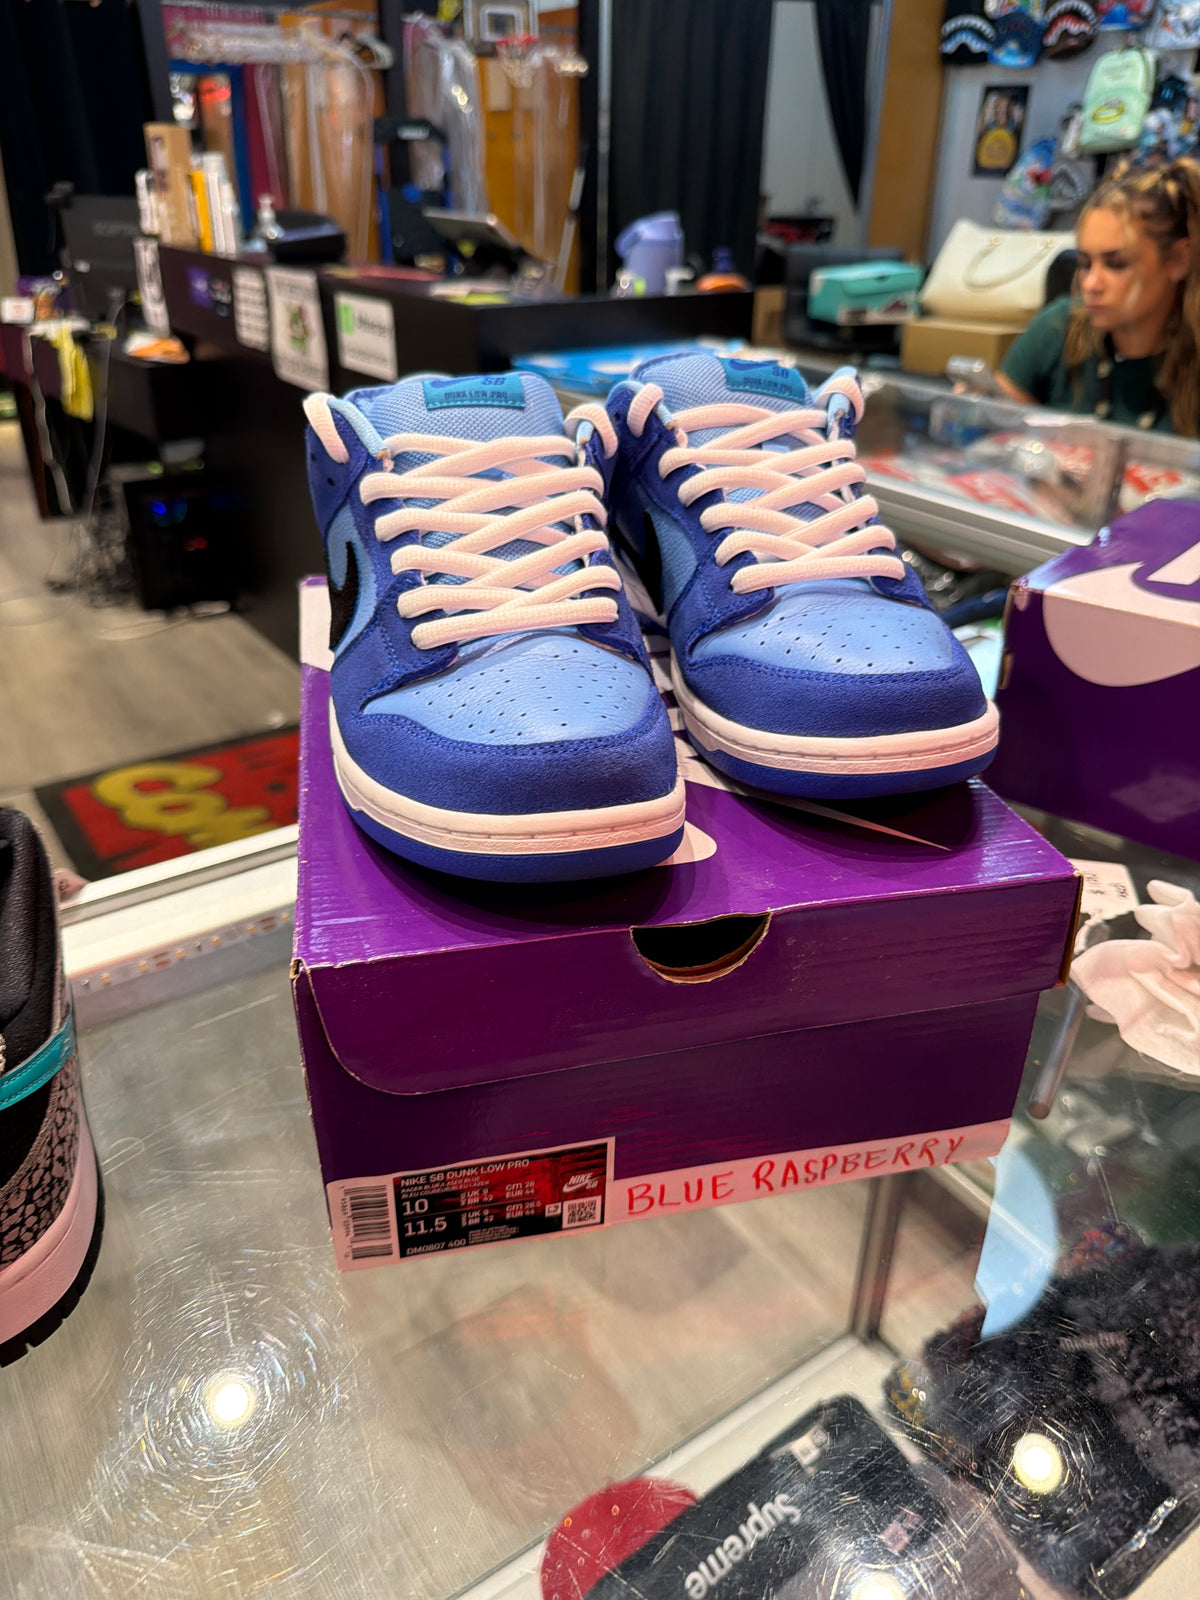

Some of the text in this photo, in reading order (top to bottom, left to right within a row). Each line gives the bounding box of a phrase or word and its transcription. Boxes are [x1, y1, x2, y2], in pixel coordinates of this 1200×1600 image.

[482, 377, 506, 386] SB
[401, 1159, 530, 1187] NIKE SB DUNK LOW PRO
[568, 1173, 593, 1184] NIKE
[627, 1136, 965, 1215] BLUE RASPBERRY
[467, 1189, 480, 1198] UK
[505, 1190, 523, 1198] EUR
[402, 1198, 428, 1217] 10
[506, 1203, 523, 1211] cm
[506, 1210, 524, 1218] EUR
[406, 1242, 445, 1255] DM0807
[683, 1492, 802, 1600] Supreme
